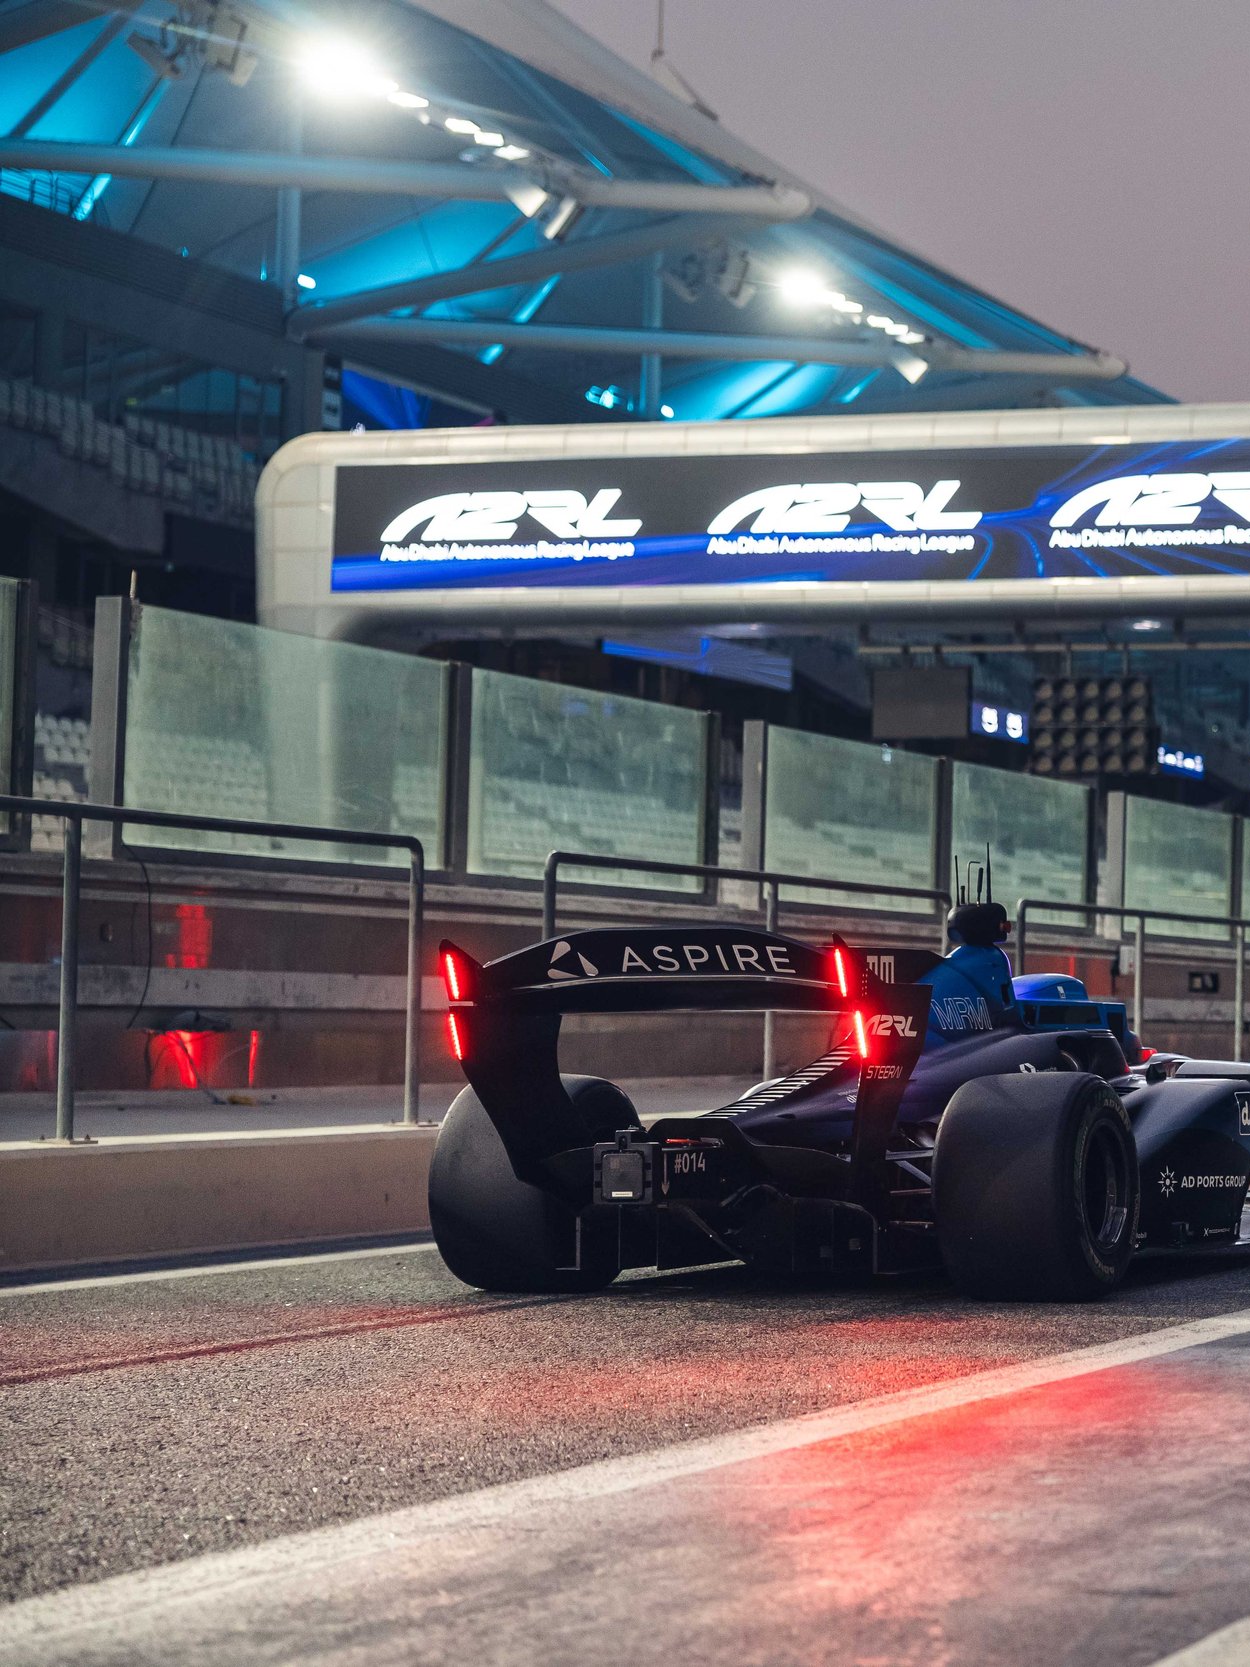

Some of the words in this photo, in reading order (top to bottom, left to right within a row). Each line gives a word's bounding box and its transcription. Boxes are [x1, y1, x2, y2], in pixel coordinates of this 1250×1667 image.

[707, 537, 737, 554] Abu
[737, 536, 779, 554] Dhabi
[779, 536, 872, 553] Autonomous
[872, 534, 920, 554] Racing
[920, 533, 974, 553] League
[1049, 530, 1081, 548] Abu
[1081, 529, 1125, 547] Dhabi
[1125, 528, 1224, 546] Autonomous
[381, 544, 409, 561] Abu
[409, 543, 449, 561] Dhabi
[449, 543, 537, 560] Autonomous
[537, 541, 583, 560] Racing
[583, 540, 634, 560] League
[621, 944, 796, 974] ASPIRE
[864, 1014, 918, 1037] A2RL
[674, 1152, 706, 1173] #014
[1181, 1176, 1195, 1188] AD
[1197, 1175, 1224, 1188] PORTS
[1224, 1175, 1247, 1188] GROUP
